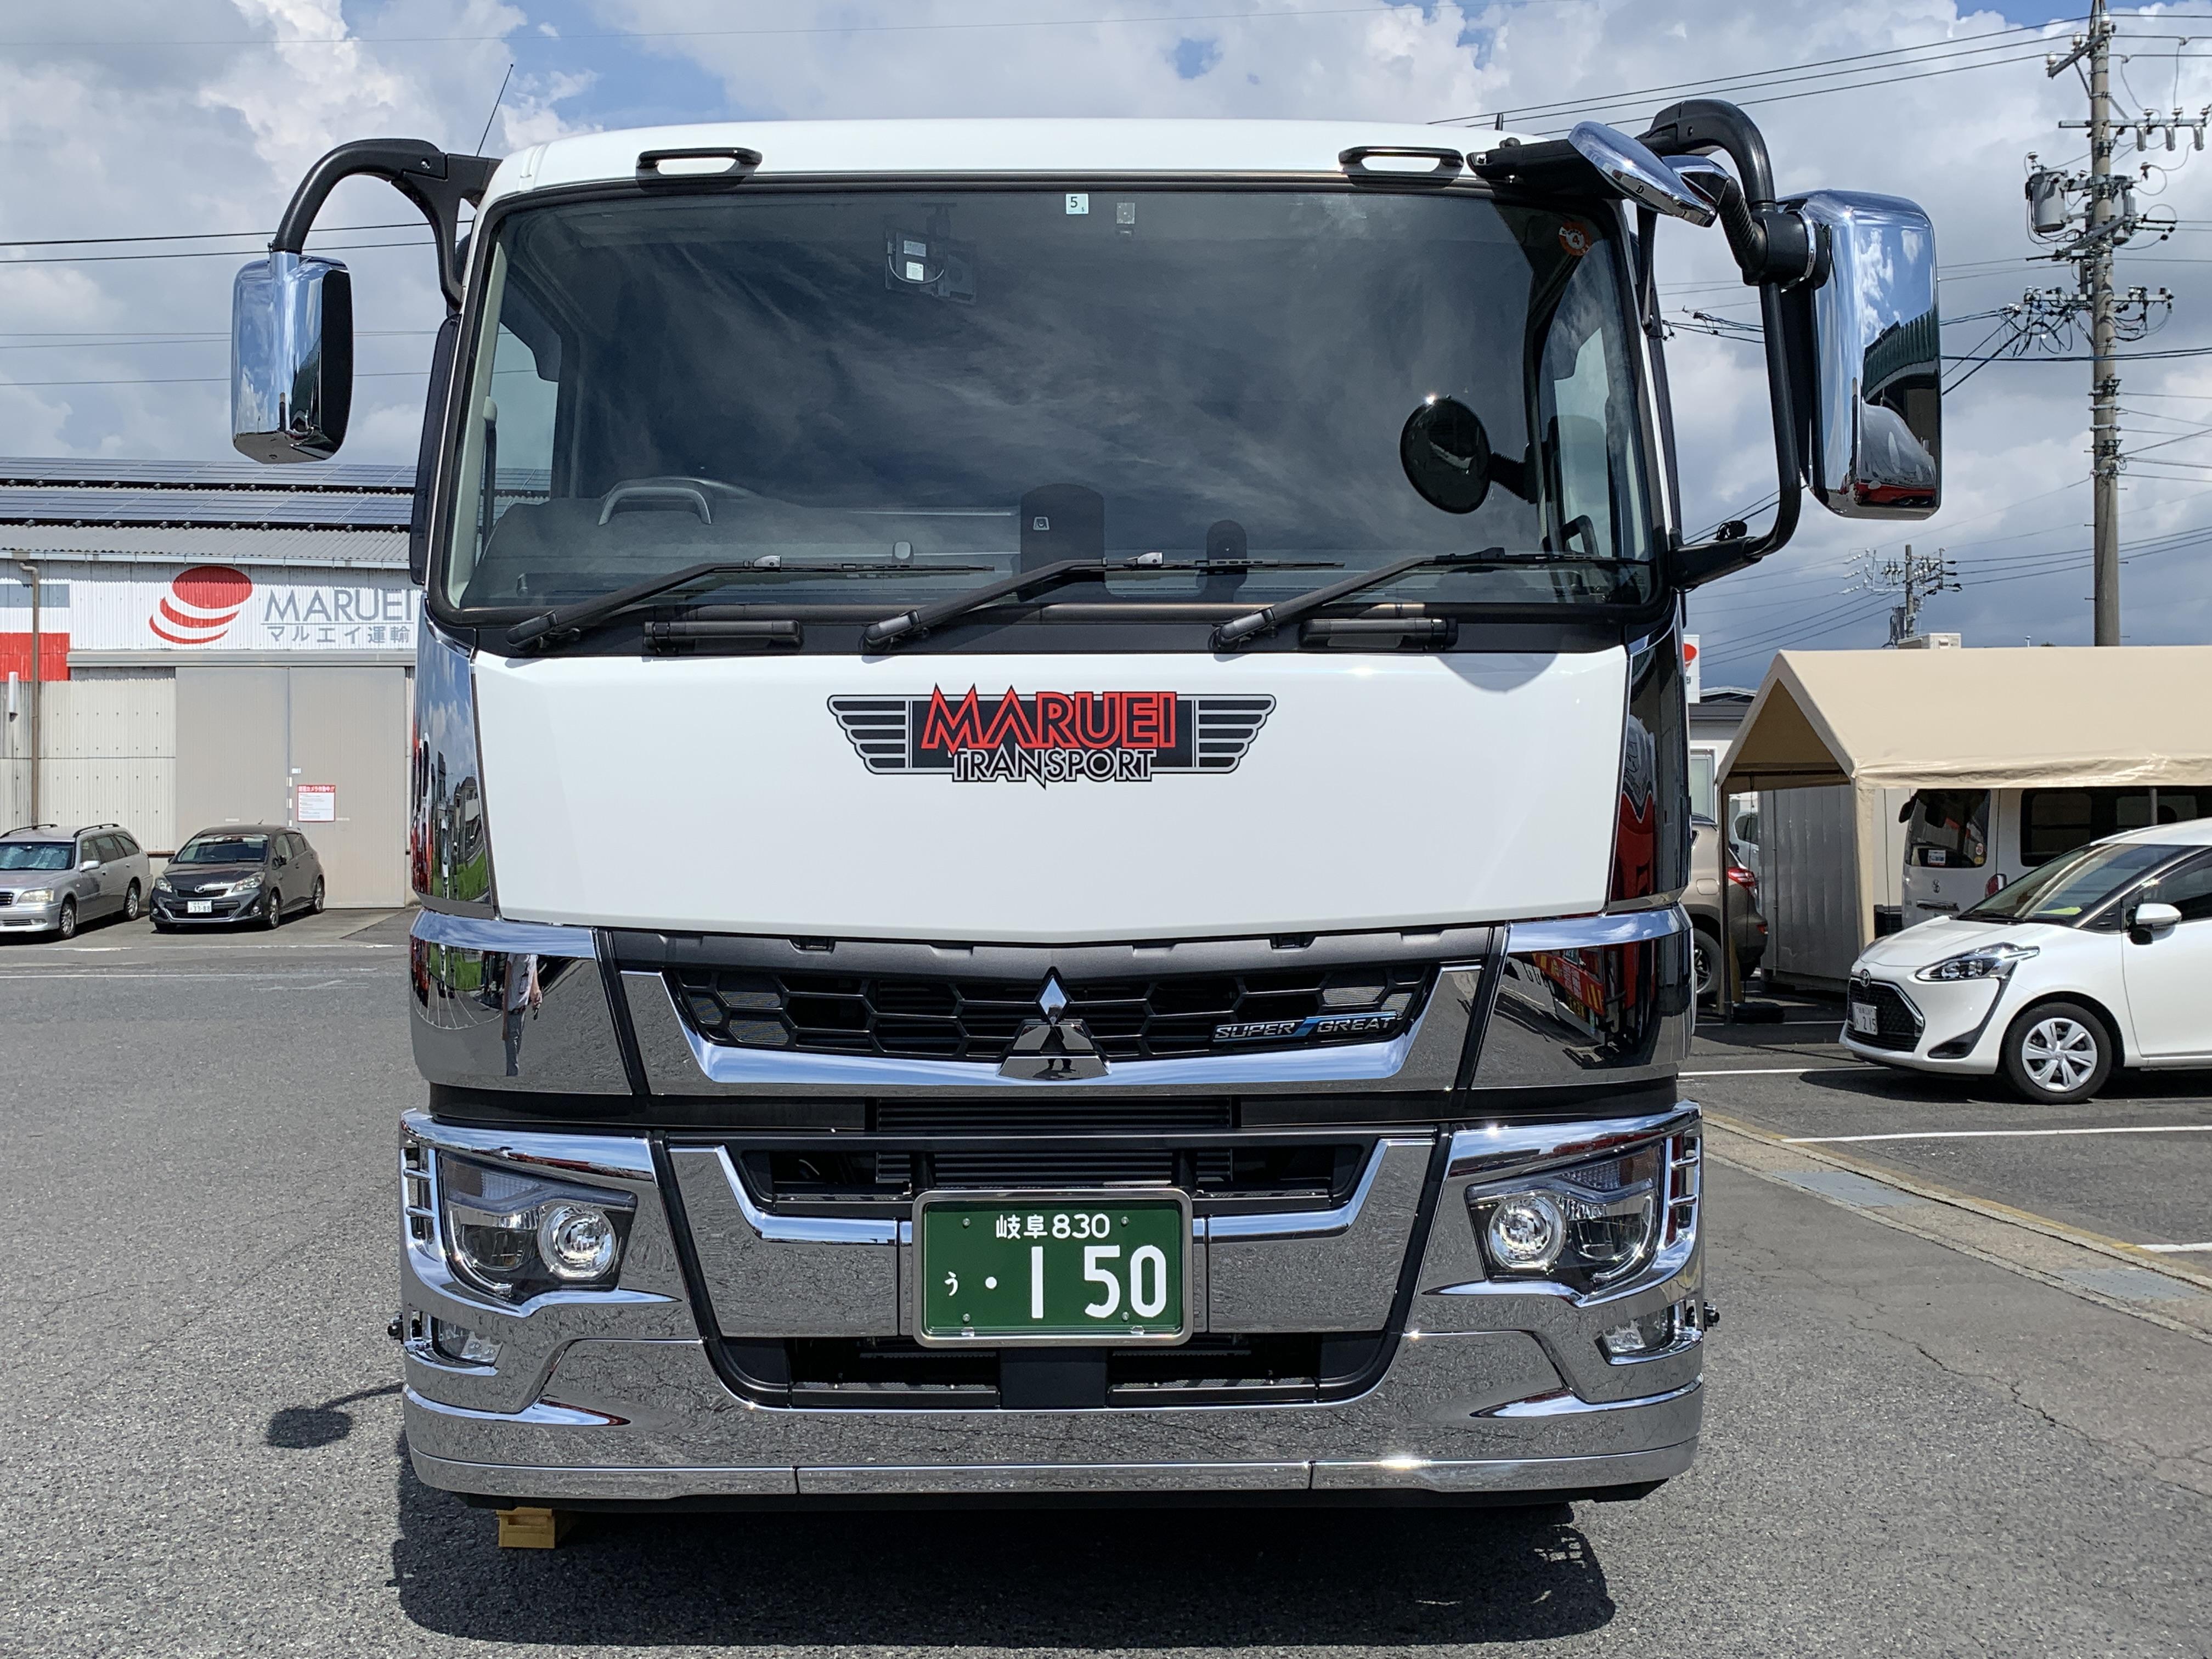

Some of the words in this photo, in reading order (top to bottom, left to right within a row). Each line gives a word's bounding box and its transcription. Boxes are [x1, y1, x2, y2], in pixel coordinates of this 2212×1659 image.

[1070, 196, 1078, 208] 5
[264, 589, 412, 622] MARUEI
[267, 626, 410, 644] マルエイ運輸
[921, 684, 1177, 754] MARUEI
[949, 744, 1158, 790] TRANSPORT
[1215, 1022, 1295, 1039] SUPER
[1317, 1017, 1396, 1032] GREAT
